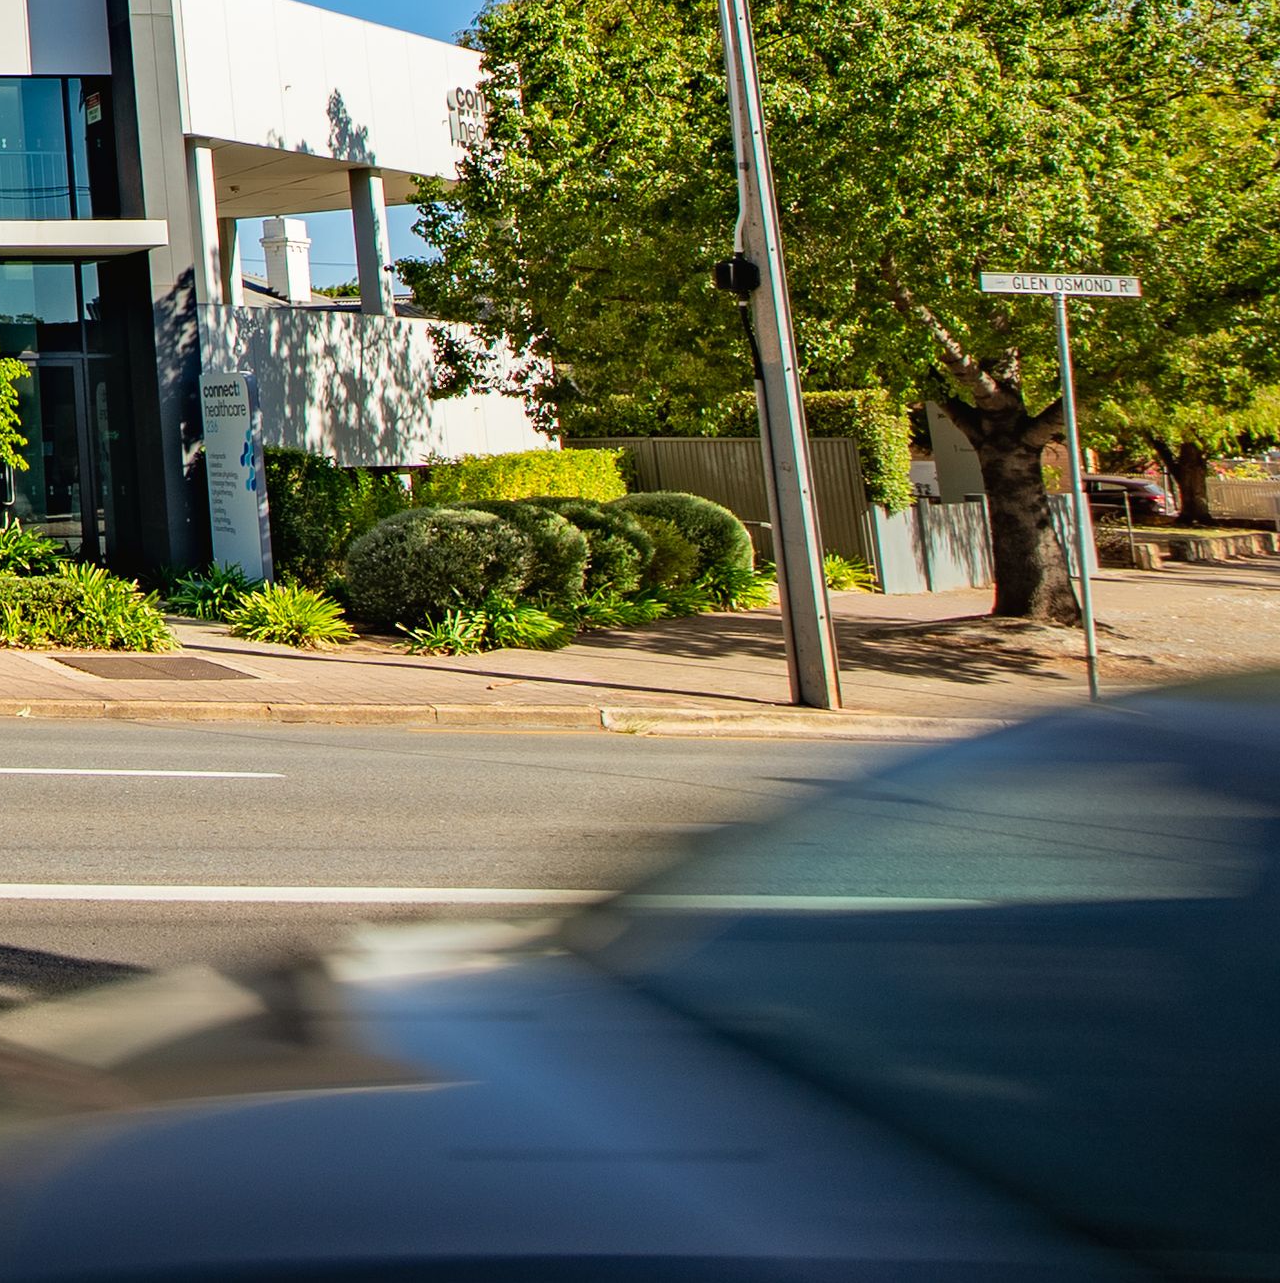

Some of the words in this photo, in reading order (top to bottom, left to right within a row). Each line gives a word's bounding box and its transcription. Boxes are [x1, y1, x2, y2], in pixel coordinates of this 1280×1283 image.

[1012, 276, 1048, 290] GLEN
[1054, 278, 1113, 293] OSMOND
[203, 380, 239, 398] connect
[205, 399, 247, 417] healthcare
